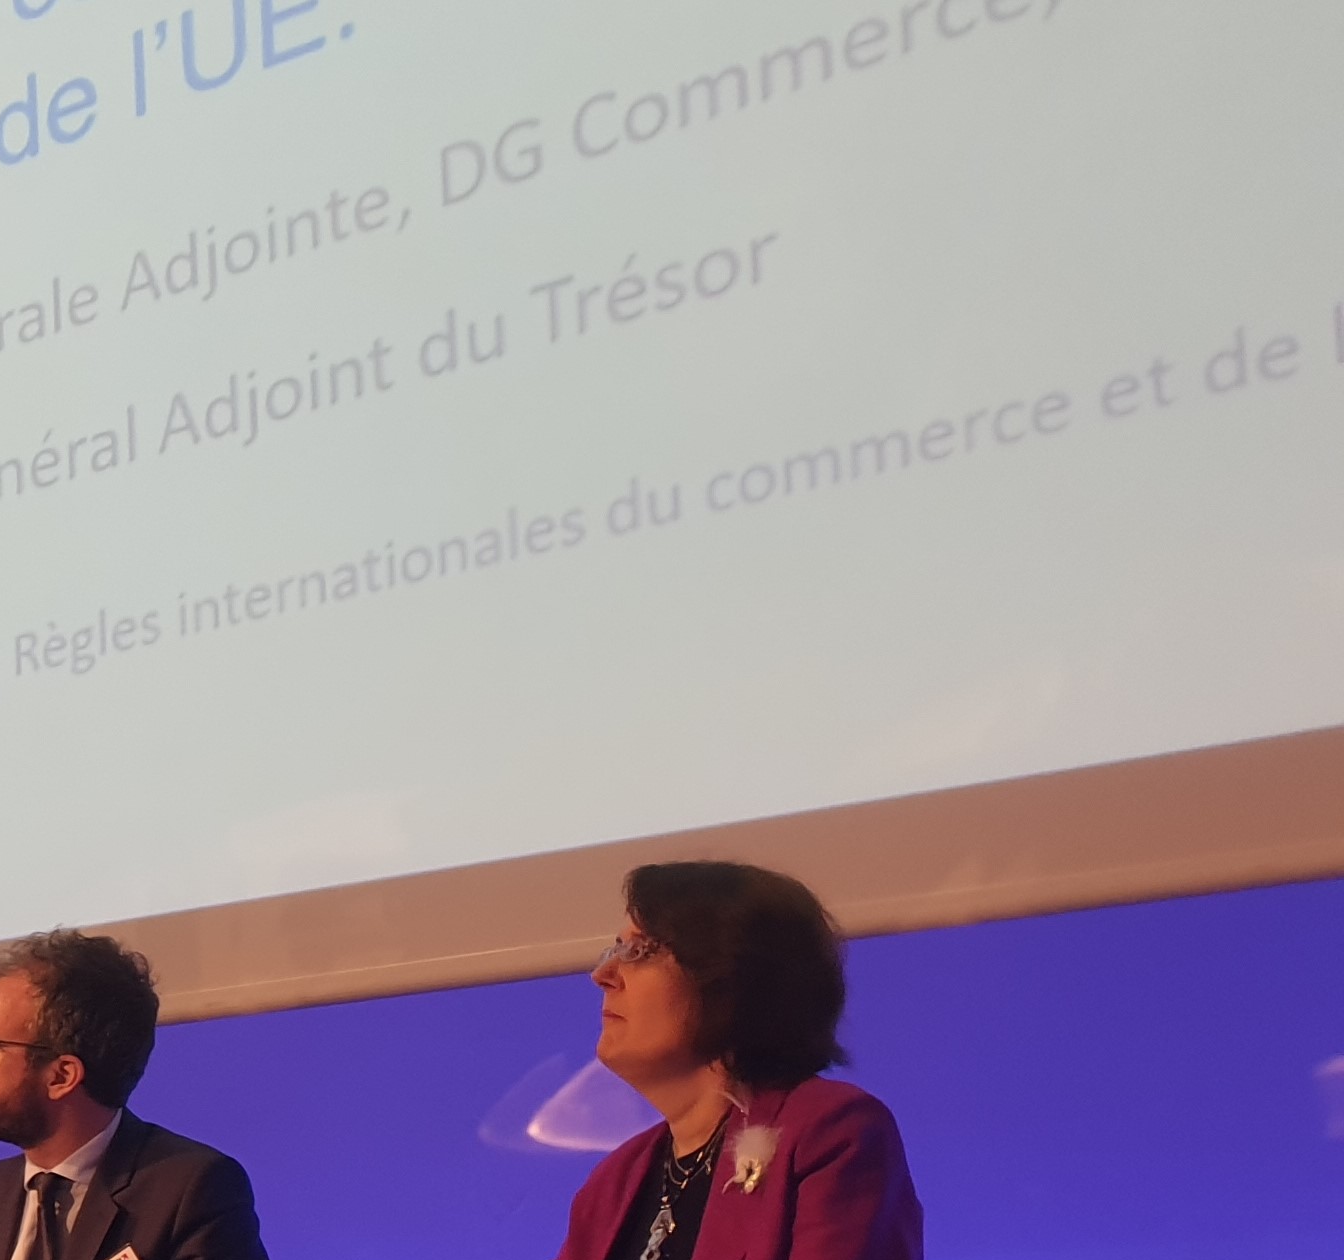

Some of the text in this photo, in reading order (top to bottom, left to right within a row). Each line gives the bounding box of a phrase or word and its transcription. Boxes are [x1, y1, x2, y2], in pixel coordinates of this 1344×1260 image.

[120, 181, 411, 311] Adjointe,
[439, 117, 545, 207] DG
[158, 336, 395, 453] Adjoint
[418, 310, 507, 379] du
[530, 231, 780, 344] Trésor
[14, 607, 162, 678] Règles
[178, 503, 587, 639] internationales
[606, 477, 682, 536] du
[706, 389, 1073, 512] commerce
[1099, 355, 1175, 417] et
[1203, 325, 1302, 395] de
